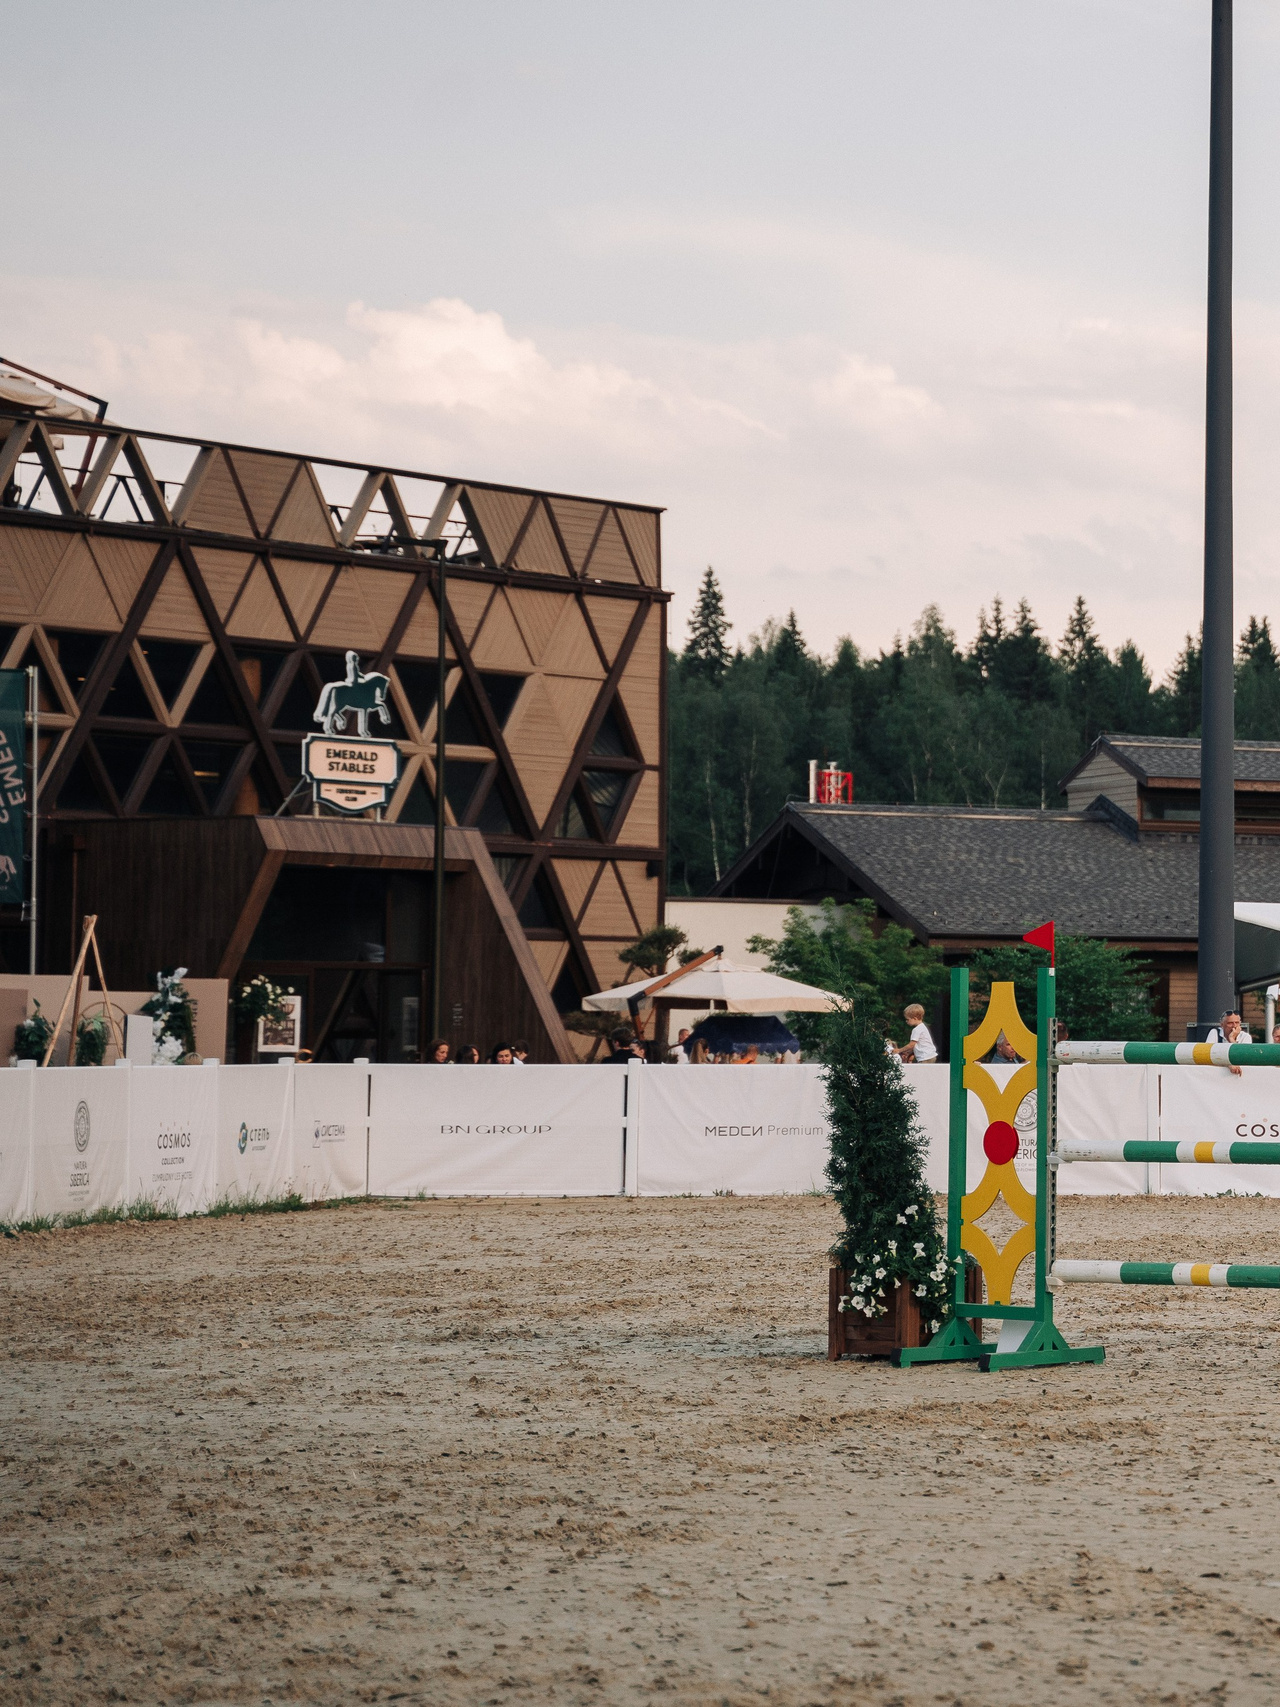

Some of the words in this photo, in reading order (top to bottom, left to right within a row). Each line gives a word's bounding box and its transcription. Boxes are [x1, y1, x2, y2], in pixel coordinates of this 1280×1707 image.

[326, 749, 378, 761] EMERALD
[328, 762, 375, 773] STABLES
[249, 1128, 270, 1142] СТЕПЬ
[440, 1125, 470, 1134] BN
[475, 1125, 552, 1135] GROUP
[767, 1125, 824, 1136] Premium
[157, 1132, 191, 1149] COSMOS
